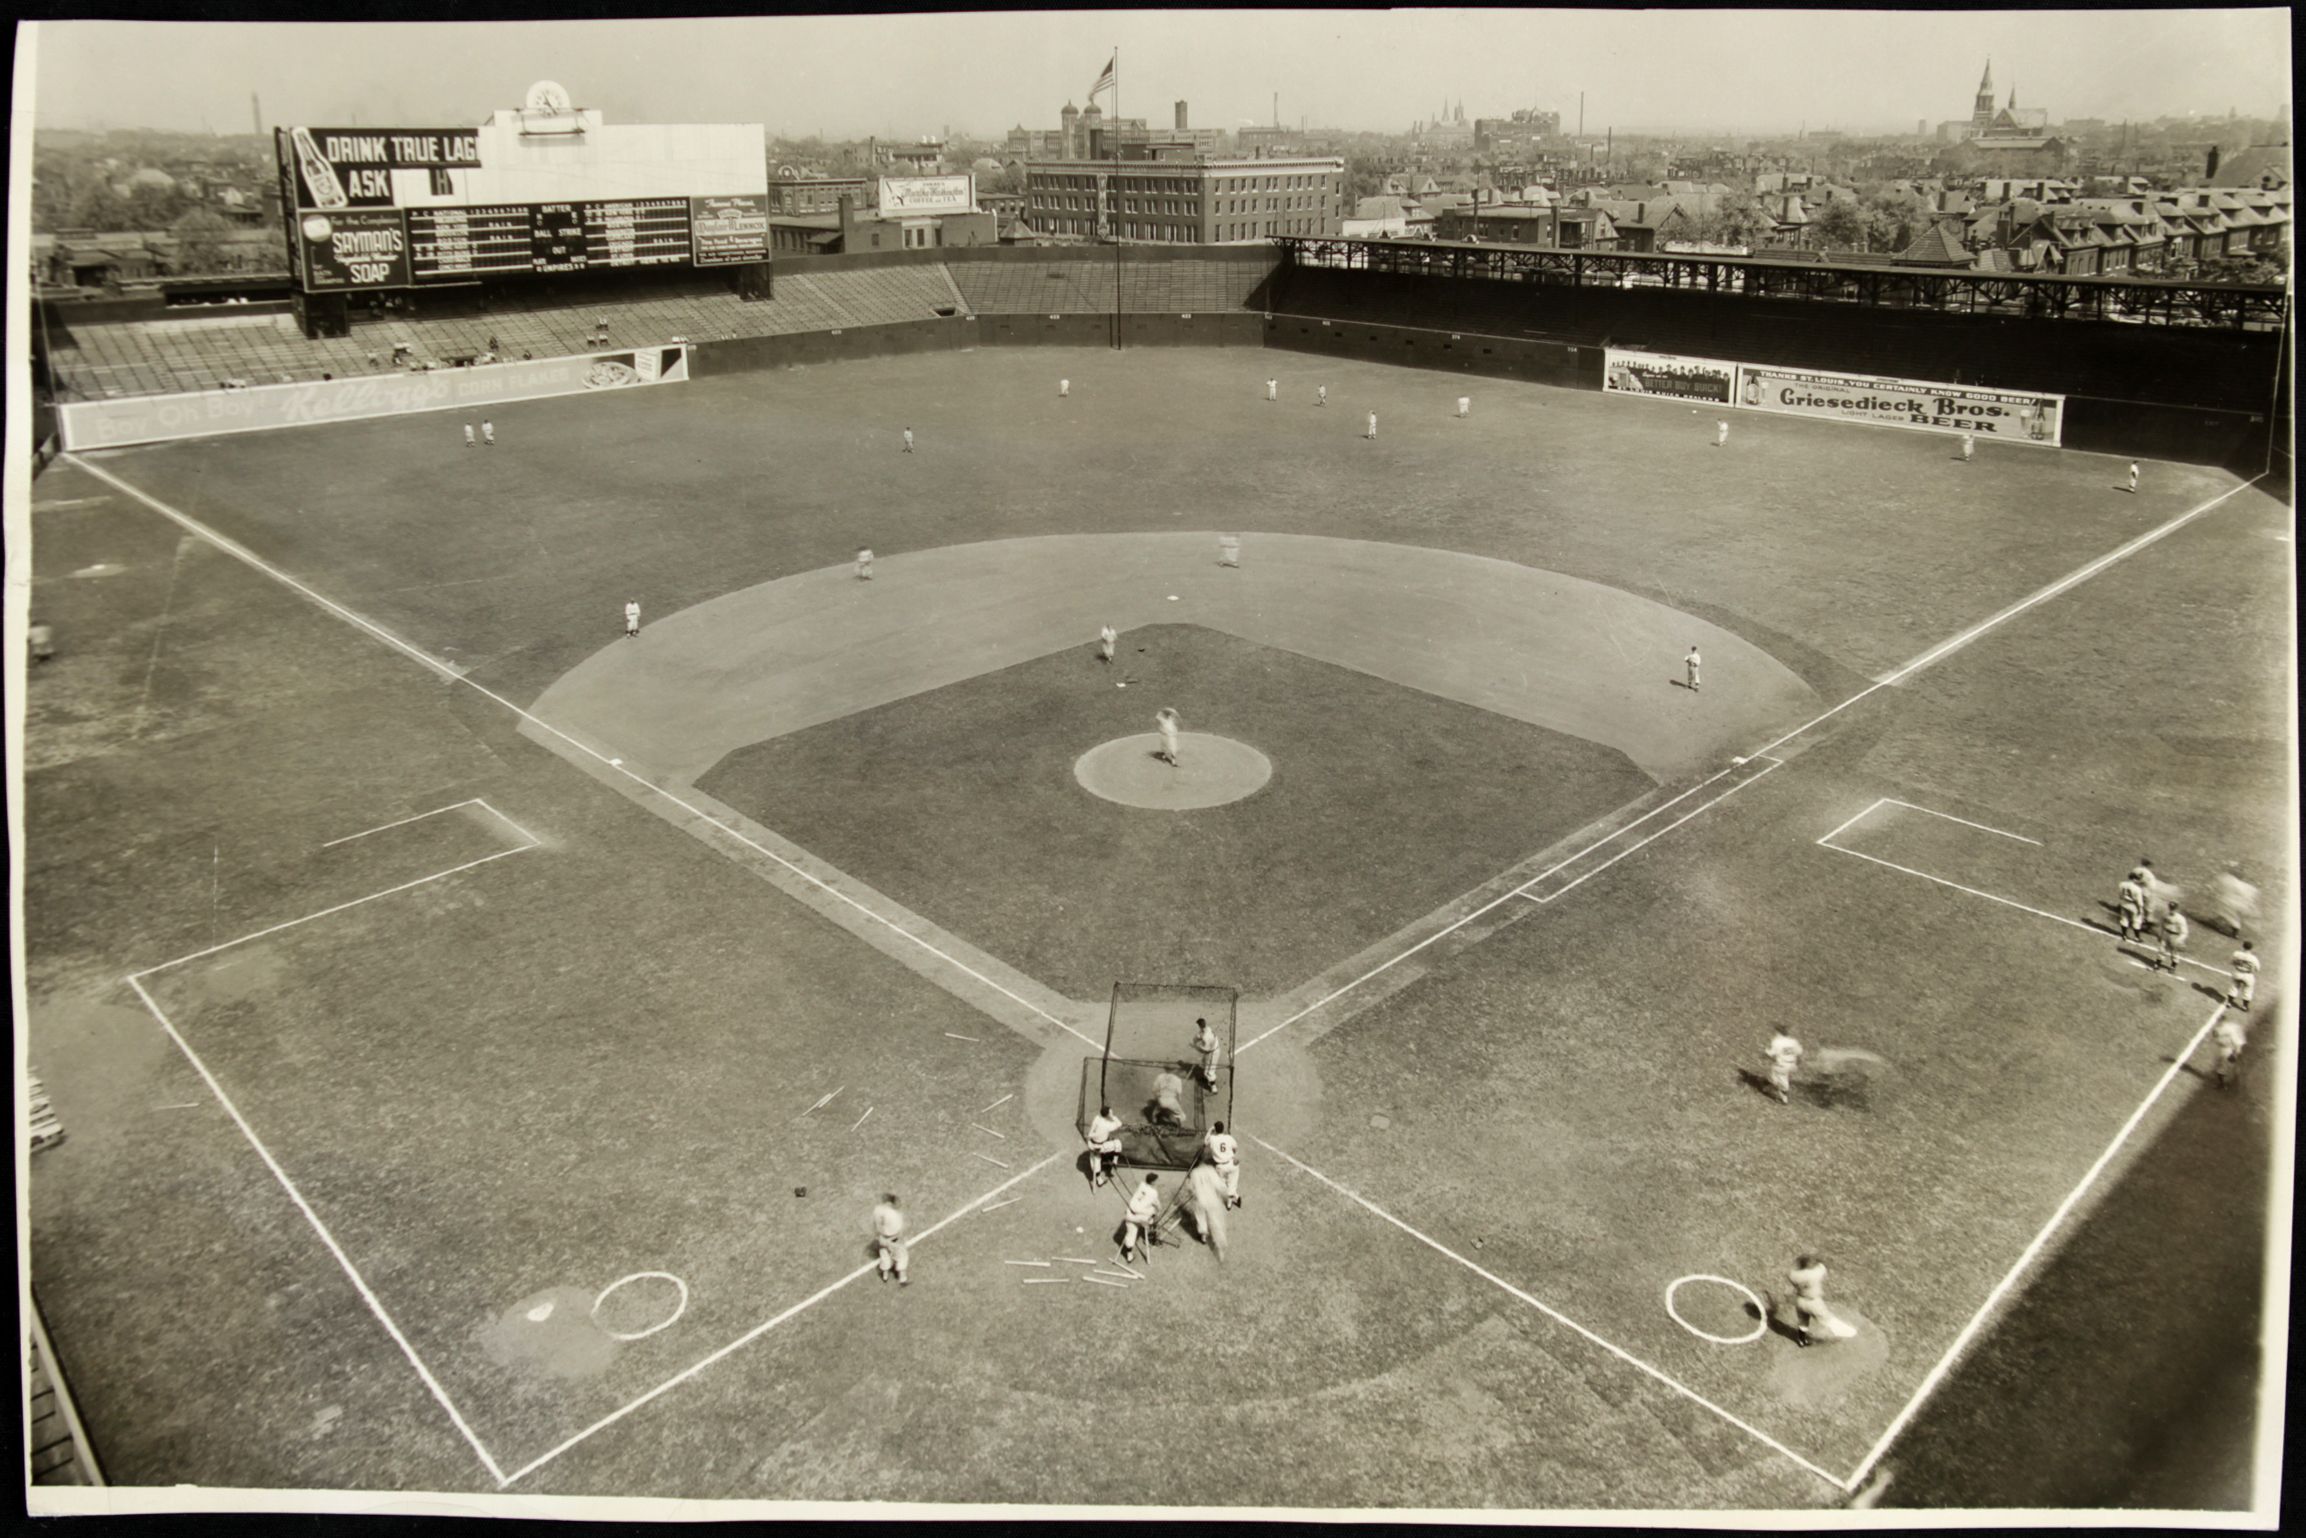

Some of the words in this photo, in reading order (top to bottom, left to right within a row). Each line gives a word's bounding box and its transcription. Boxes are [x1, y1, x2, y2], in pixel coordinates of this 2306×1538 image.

[326, 136, 388, 162] DRINK
[391, 136, 439, 162] TRUE
[348, 169, 390, 198] ASK
[542, 204, 571, 213] BATTER
[346, 215, 360, 225] the
[735, 220, 766, 232] LENNOX
[534, 229, 553, 238] BALL
[558, 228, 582, 237] STRIKE
[552, 246, 566, 255] OUT
[350, 262, 390, 283] SOAP
[458, 380, 503, 397] CORN
[509, 366, 569, 390] FLAKES
[1645, 379, 1673, 389] BETTER
[1675, 381, 1691, 390] BUY
[1760, 370, 1797, 381] THANKS
[1849, 379, 1870, 389] YOU
[1873, 383, 1927, 395] CERTAINLY
[1931, 388, 1961, 399] KNOW
[1966, 393, 1997, 402] GOOD
[2001, 396, 2036, 406] BEER!
[1795, 382, 1808, 390] THE
[1812, 384, 1851, 394] ORIGINAL
[281, 376, 448, 422] Kellogg's
[1780, 387, 1926, 416] Griesedieck
[1931, 397, 2011, 419] Bros.
[96, 417, 148, 441] Boy
[159, 403, 199, 427] Oh
[1841, 410, 1869, 418] LIGHT
[1872, 412, 1904, 421] LAGER
[1910, 413, 1998, 433] BEER
[1220, 1142, 1226, 1153] 6
